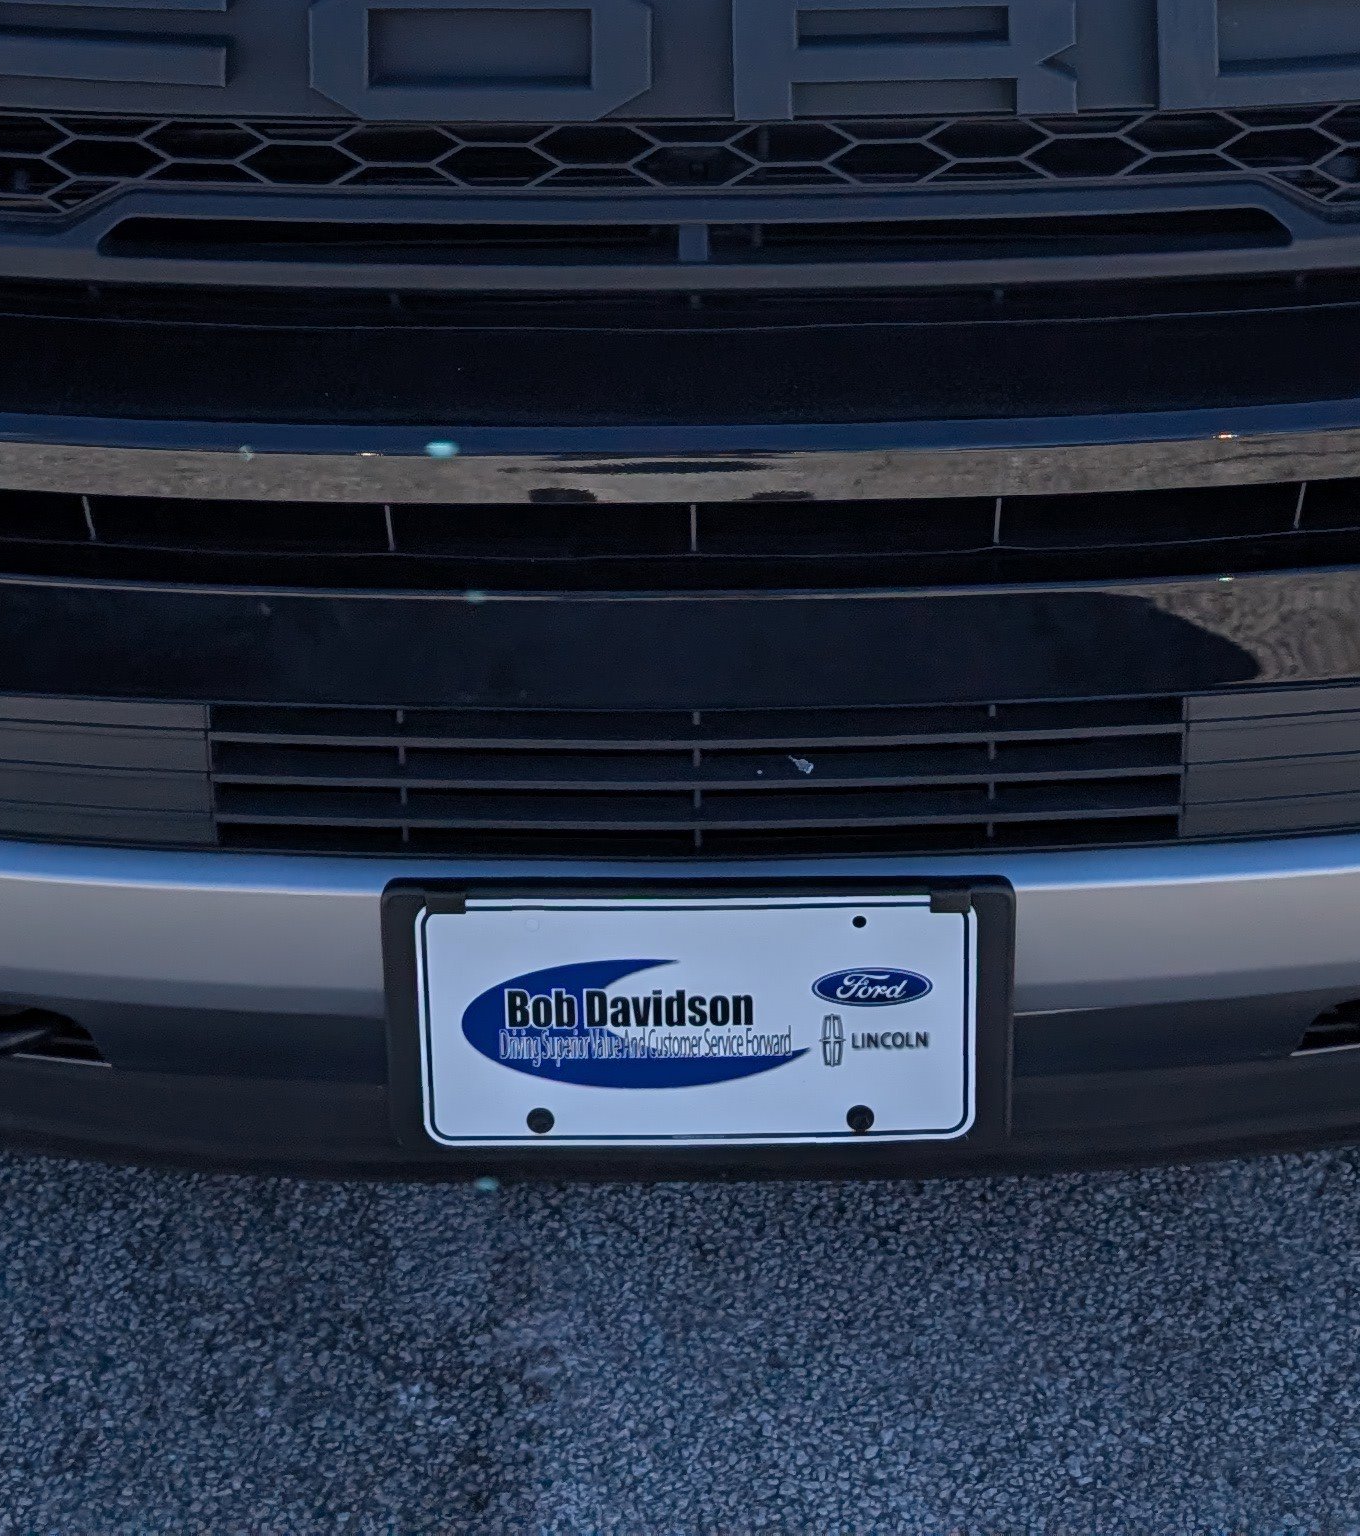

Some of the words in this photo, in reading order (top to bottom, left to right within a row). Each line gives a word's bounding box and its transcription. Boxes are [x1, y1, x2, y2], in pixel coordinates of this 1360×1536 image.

[835, 973, 908, 999] Ford
[505, 988, 578, 1029] Bob
[584, 988, 754, 1028] Davidson
[499, 1028, 542, 1068] Driving
[541, 1028, 591, 1068] Superior
[589, 1027, 623, 1060] Value
[621, 1027, 647, 1059] And
[647, 1027, 702, 1058] Customer
[703, 1027, 744, 1057] Service
[745, 1024, 792, 1057] Forward
[851, 1031, 929, 1050] LINCOLN
